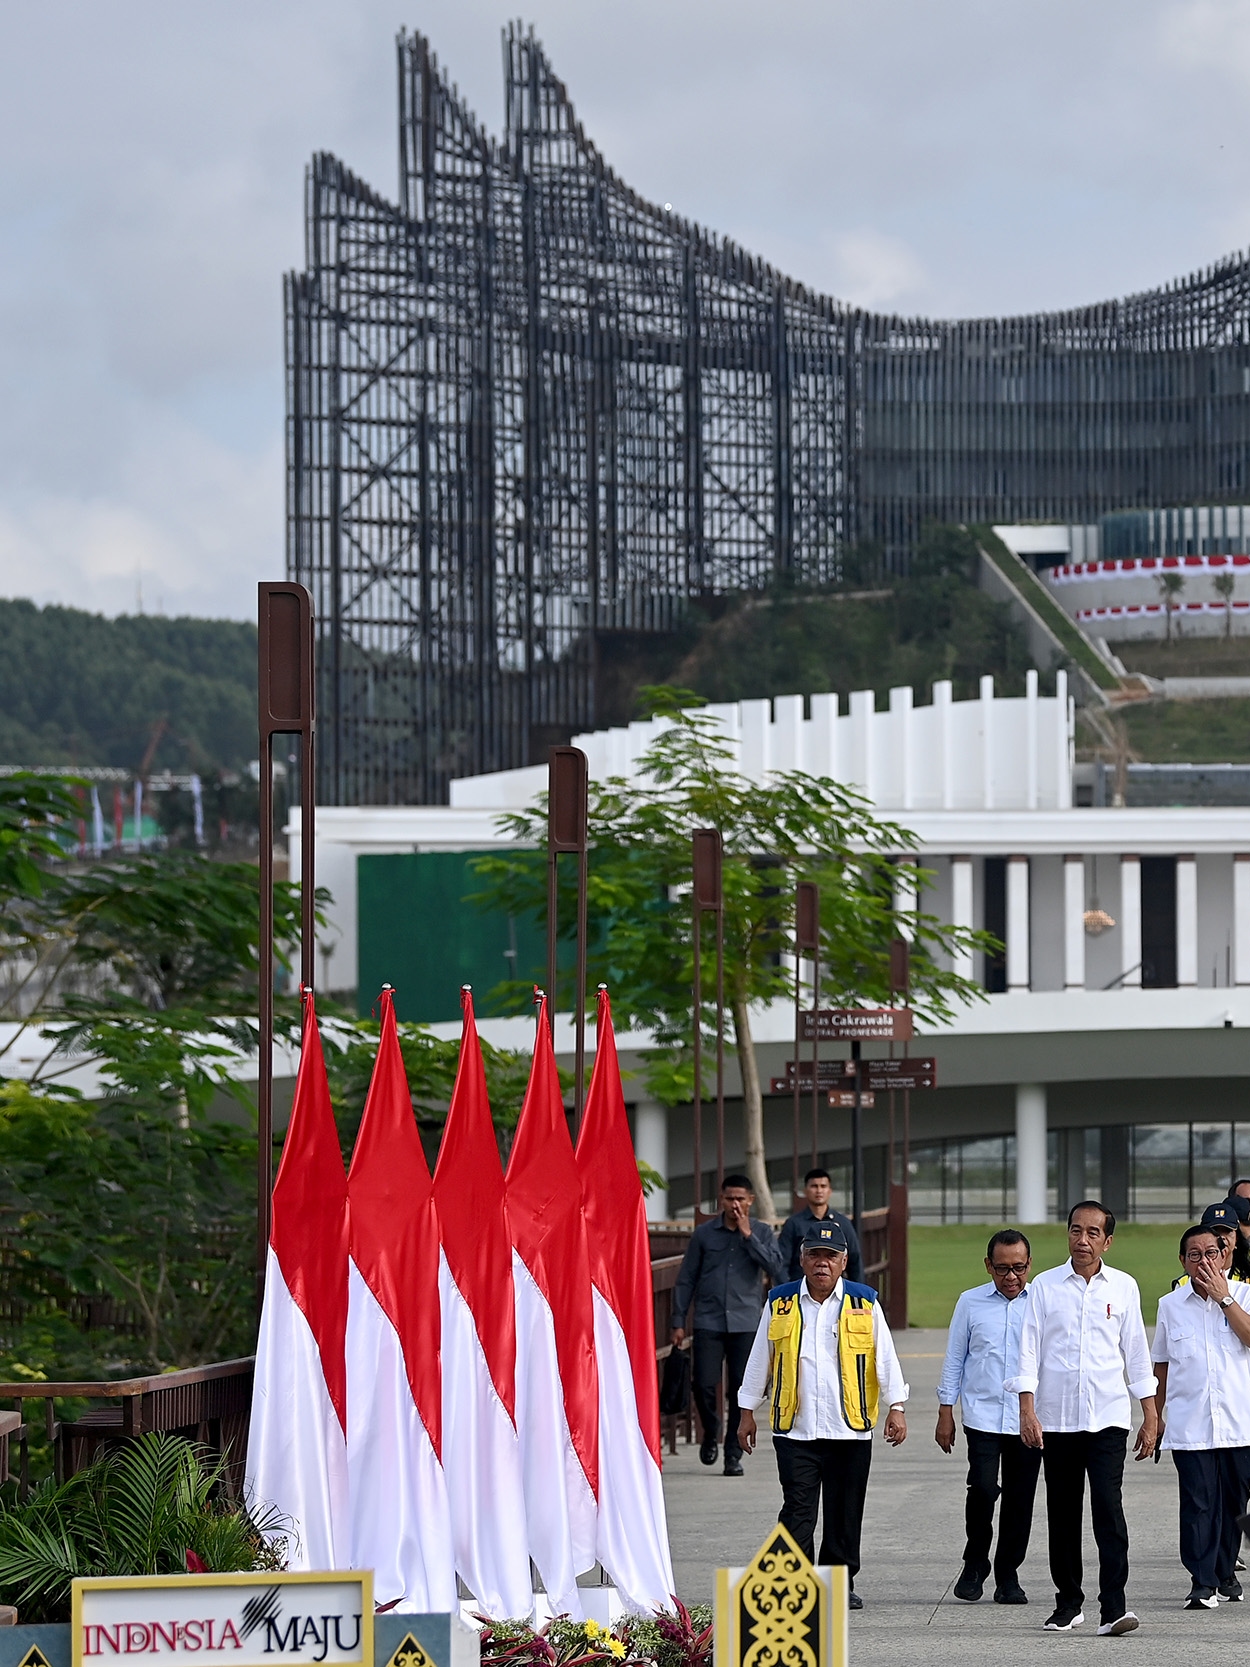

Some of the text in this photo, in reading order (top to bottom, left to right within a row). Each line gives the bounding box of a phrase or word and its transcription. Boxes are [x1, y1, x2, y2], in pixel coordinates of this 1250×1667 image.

[805, 1013, 894, 1026] Teas Cakrawala
[839, 1028, 894, 1037] PROMENADE
[262, 1613, 362, 1662] MAJU
